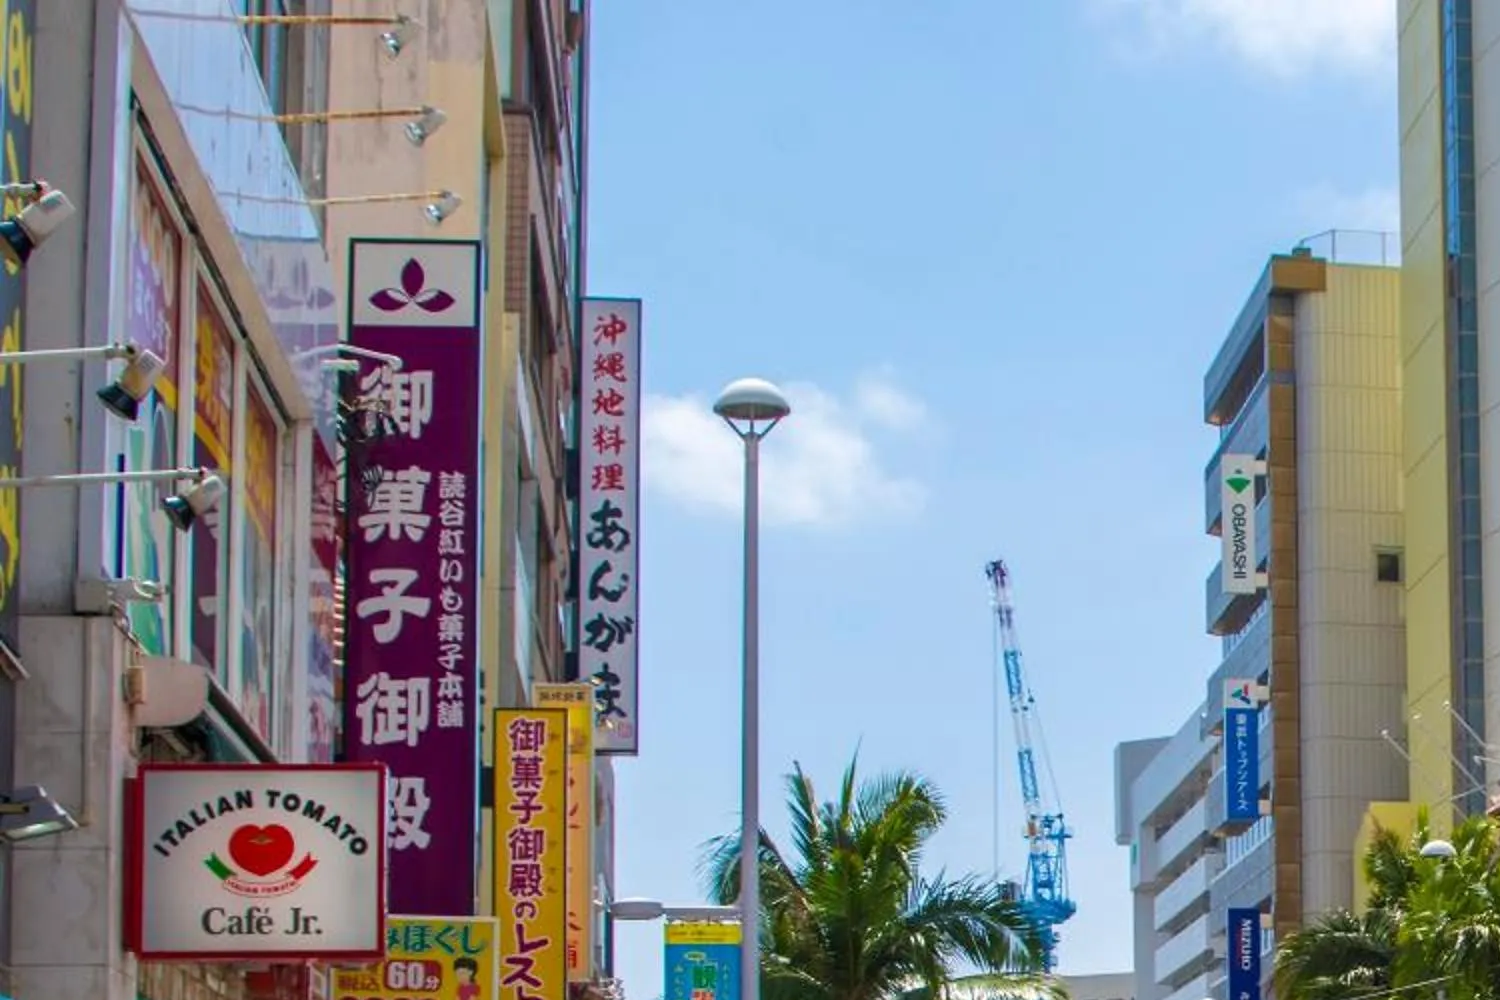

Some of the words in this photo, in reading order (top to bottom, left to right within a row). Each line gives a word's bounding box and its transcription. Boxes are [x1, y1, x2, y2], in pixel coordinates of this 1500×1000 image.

[591, 313, 628, 492] 沖縄地料理
[1231, 503, 1248, 579] OBAYASHI
[581, 499, 634, 720] あんがま
[153, 790, 253, 857] ITALIAN
[266, 789, 369, 856] TOMATO
[201, 907, 274, 936] Café
[284, 907, 323, 936] Jr.
